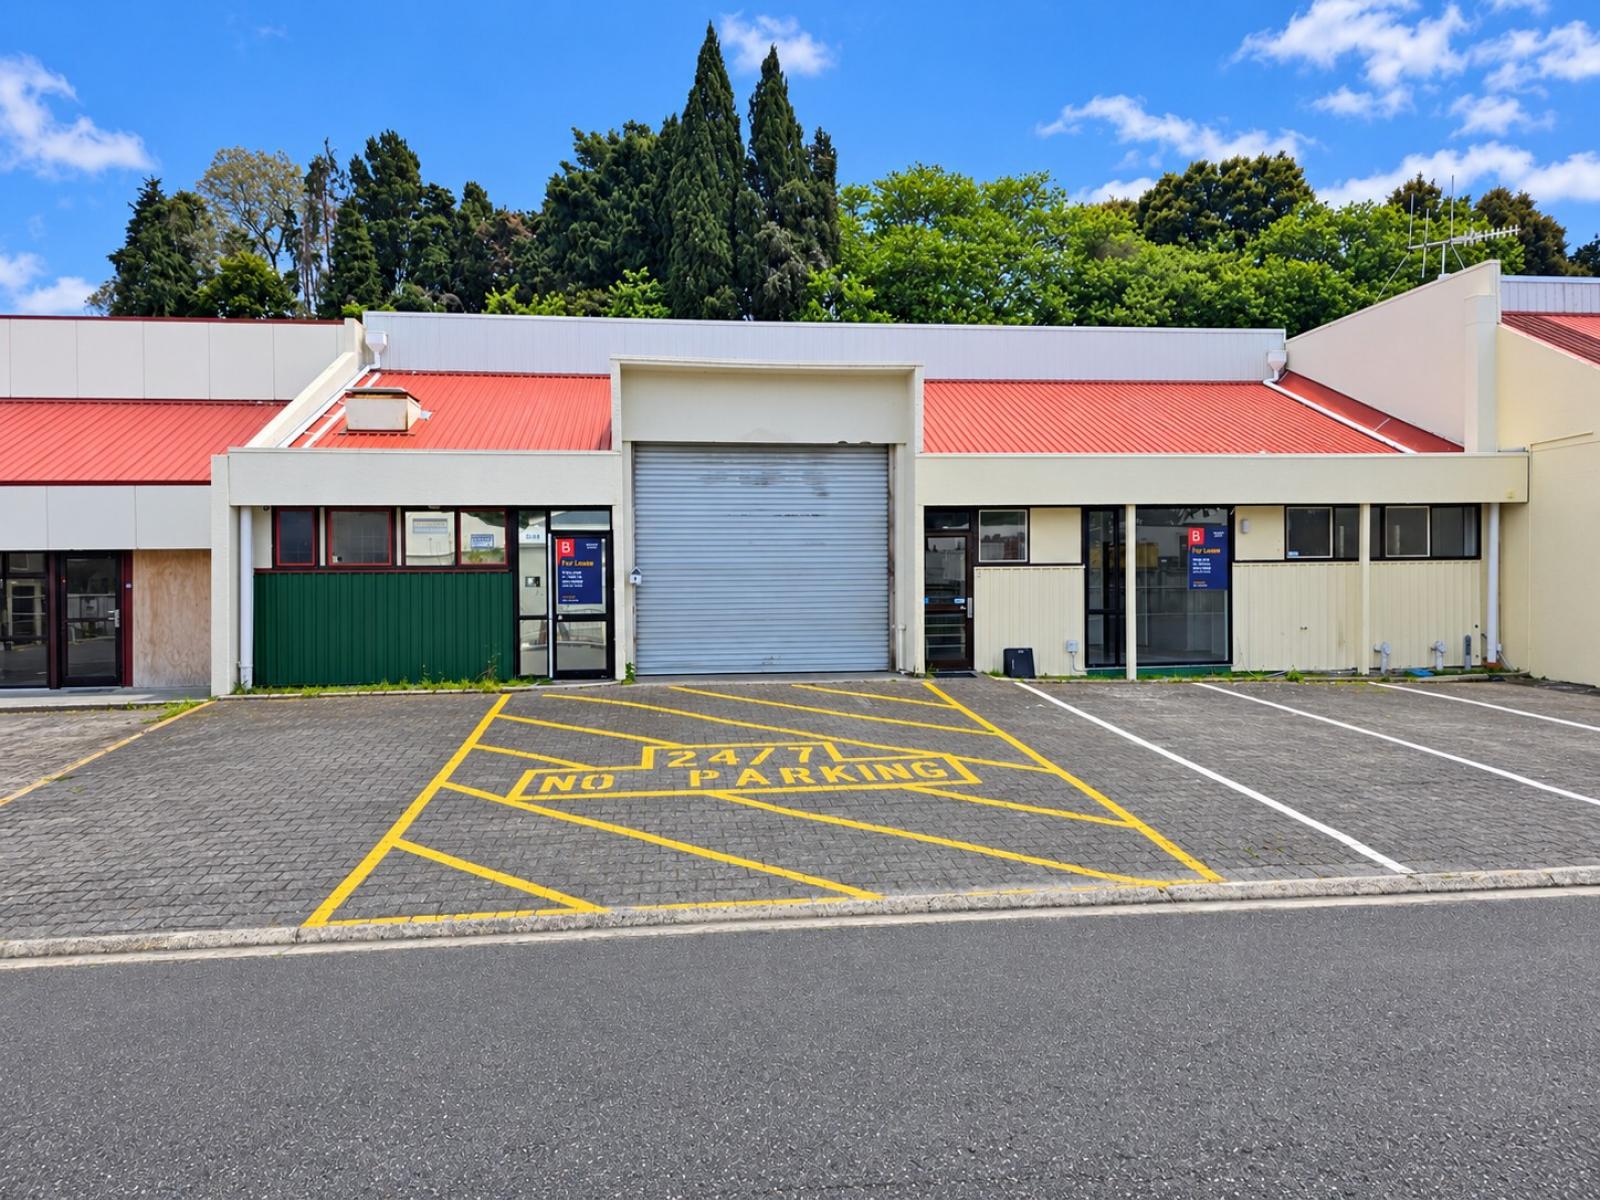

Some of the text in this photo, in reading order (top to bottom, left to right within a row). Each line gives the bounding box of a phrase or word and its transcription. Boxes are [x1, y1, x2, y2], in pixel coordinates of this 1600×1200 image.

[1193, 531, 1200, 541] B
[562, 542, 570, 553] B
[666, 747, 813, 768] 24/7
[538, 761, 948, 793] NO PARKING
